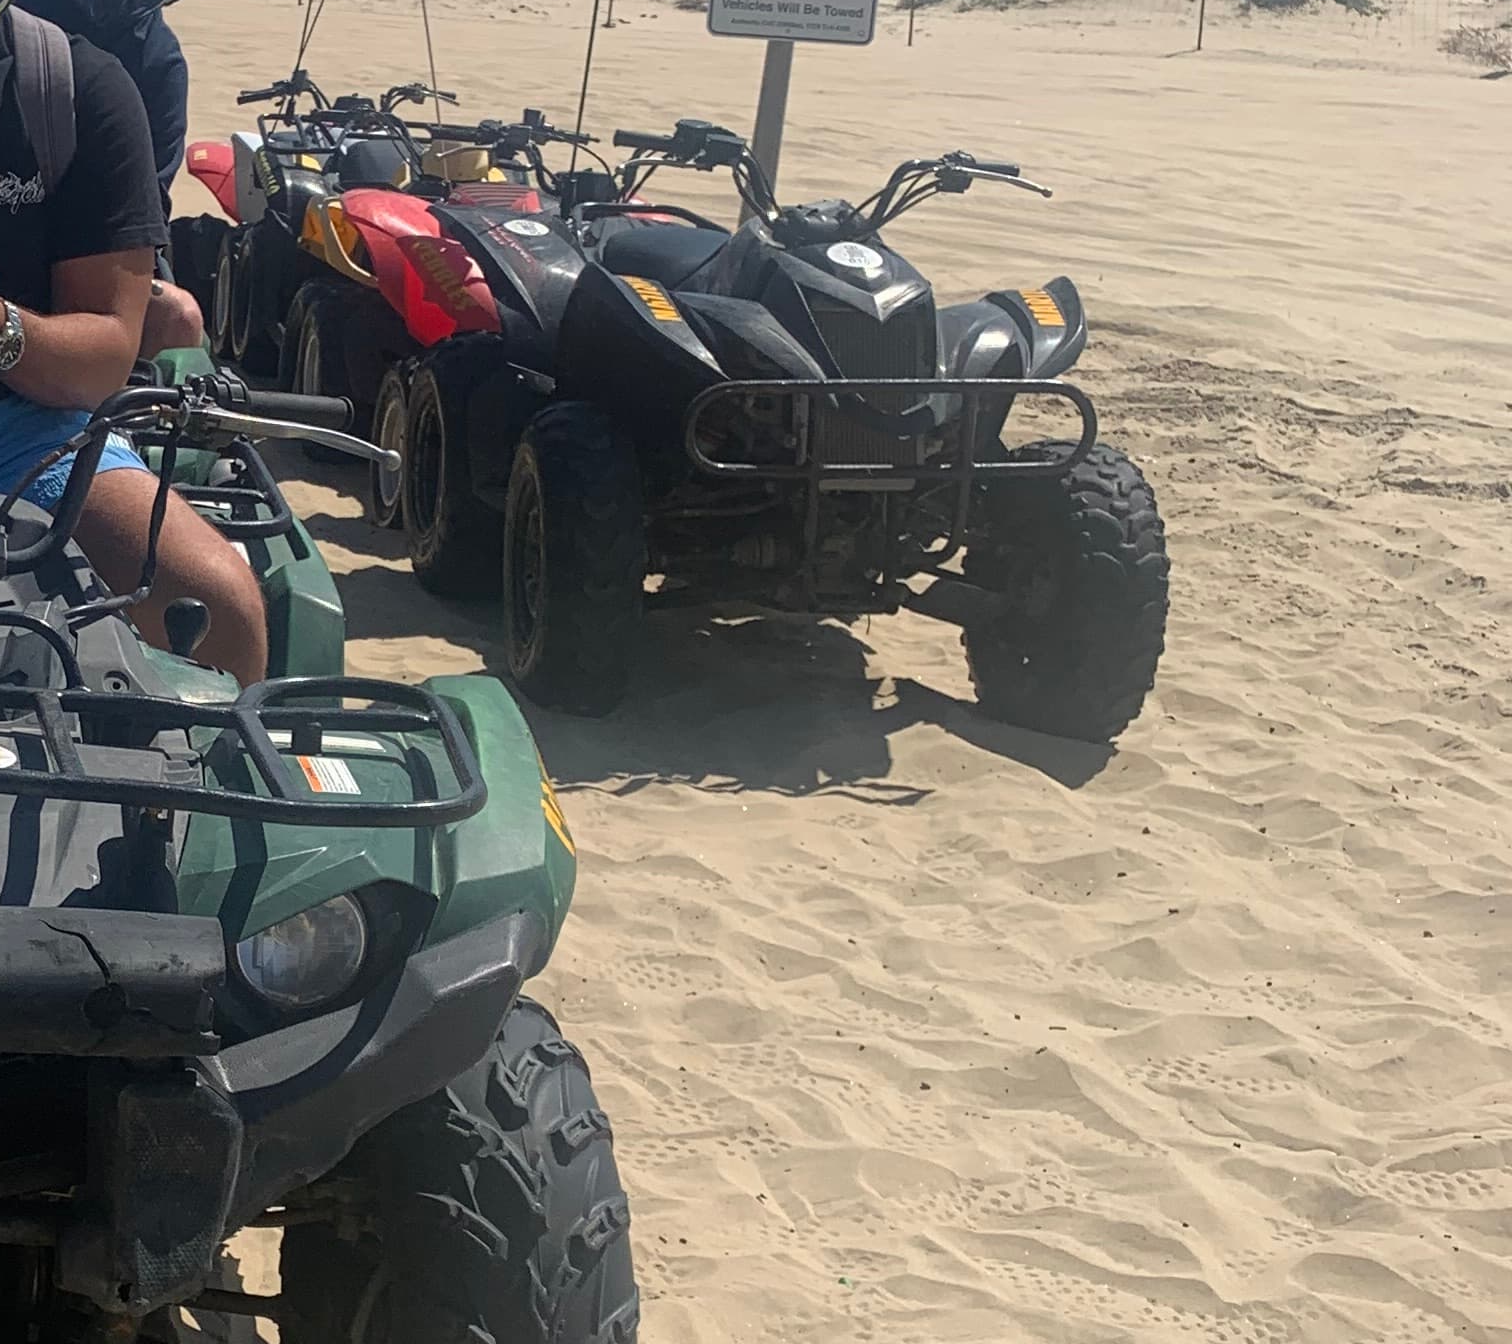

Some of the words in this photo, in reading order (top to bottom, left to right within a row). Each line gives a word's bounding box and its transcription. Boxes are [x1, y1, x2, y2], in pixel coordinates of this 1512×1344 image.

[777, 0, 801, 15] Will
[803, 3, 820, 17] Be
[824, 5, 865, 19] Towed
